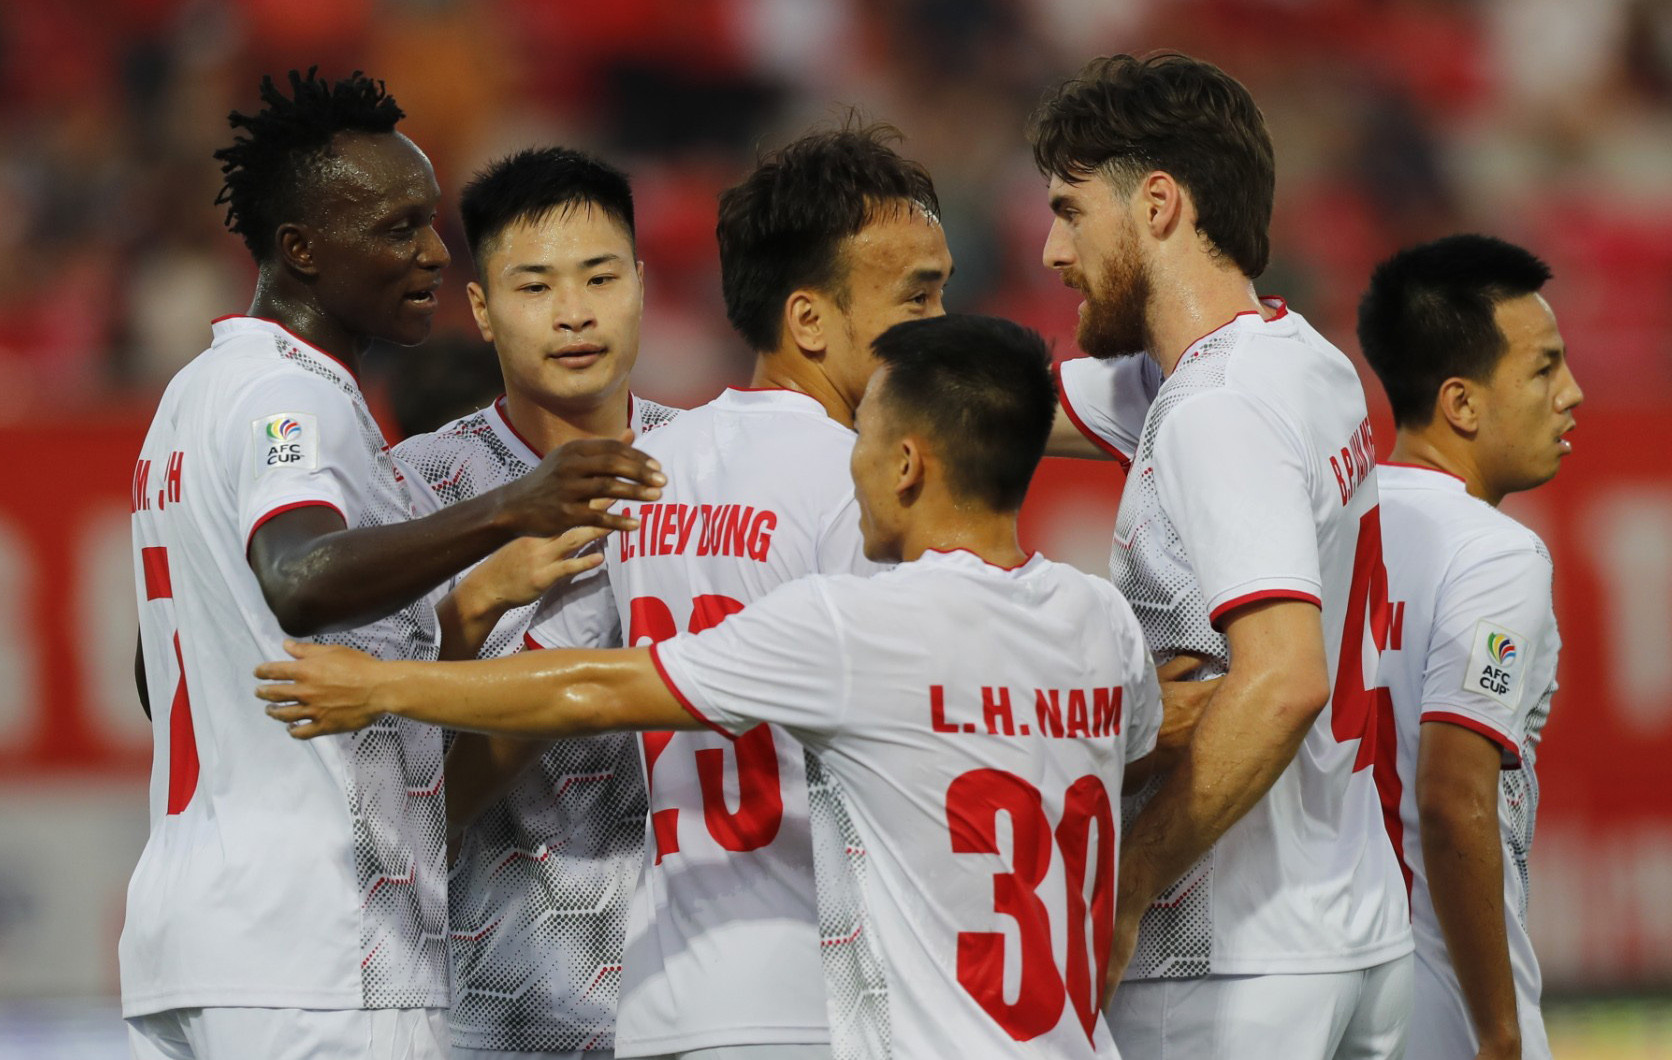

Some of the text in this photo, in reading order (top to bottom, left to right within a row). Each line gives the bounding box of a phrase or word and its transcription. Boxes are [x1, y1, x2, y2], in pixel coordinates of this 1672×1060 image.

[267, 453, 301, 466] CUP
[268, 444, 301, 457] AFC
[1482, 665, 1511, 686] AFC
[1479, 676, 1508, 696] CUP
[945, 767, 1115, 1052] 30
